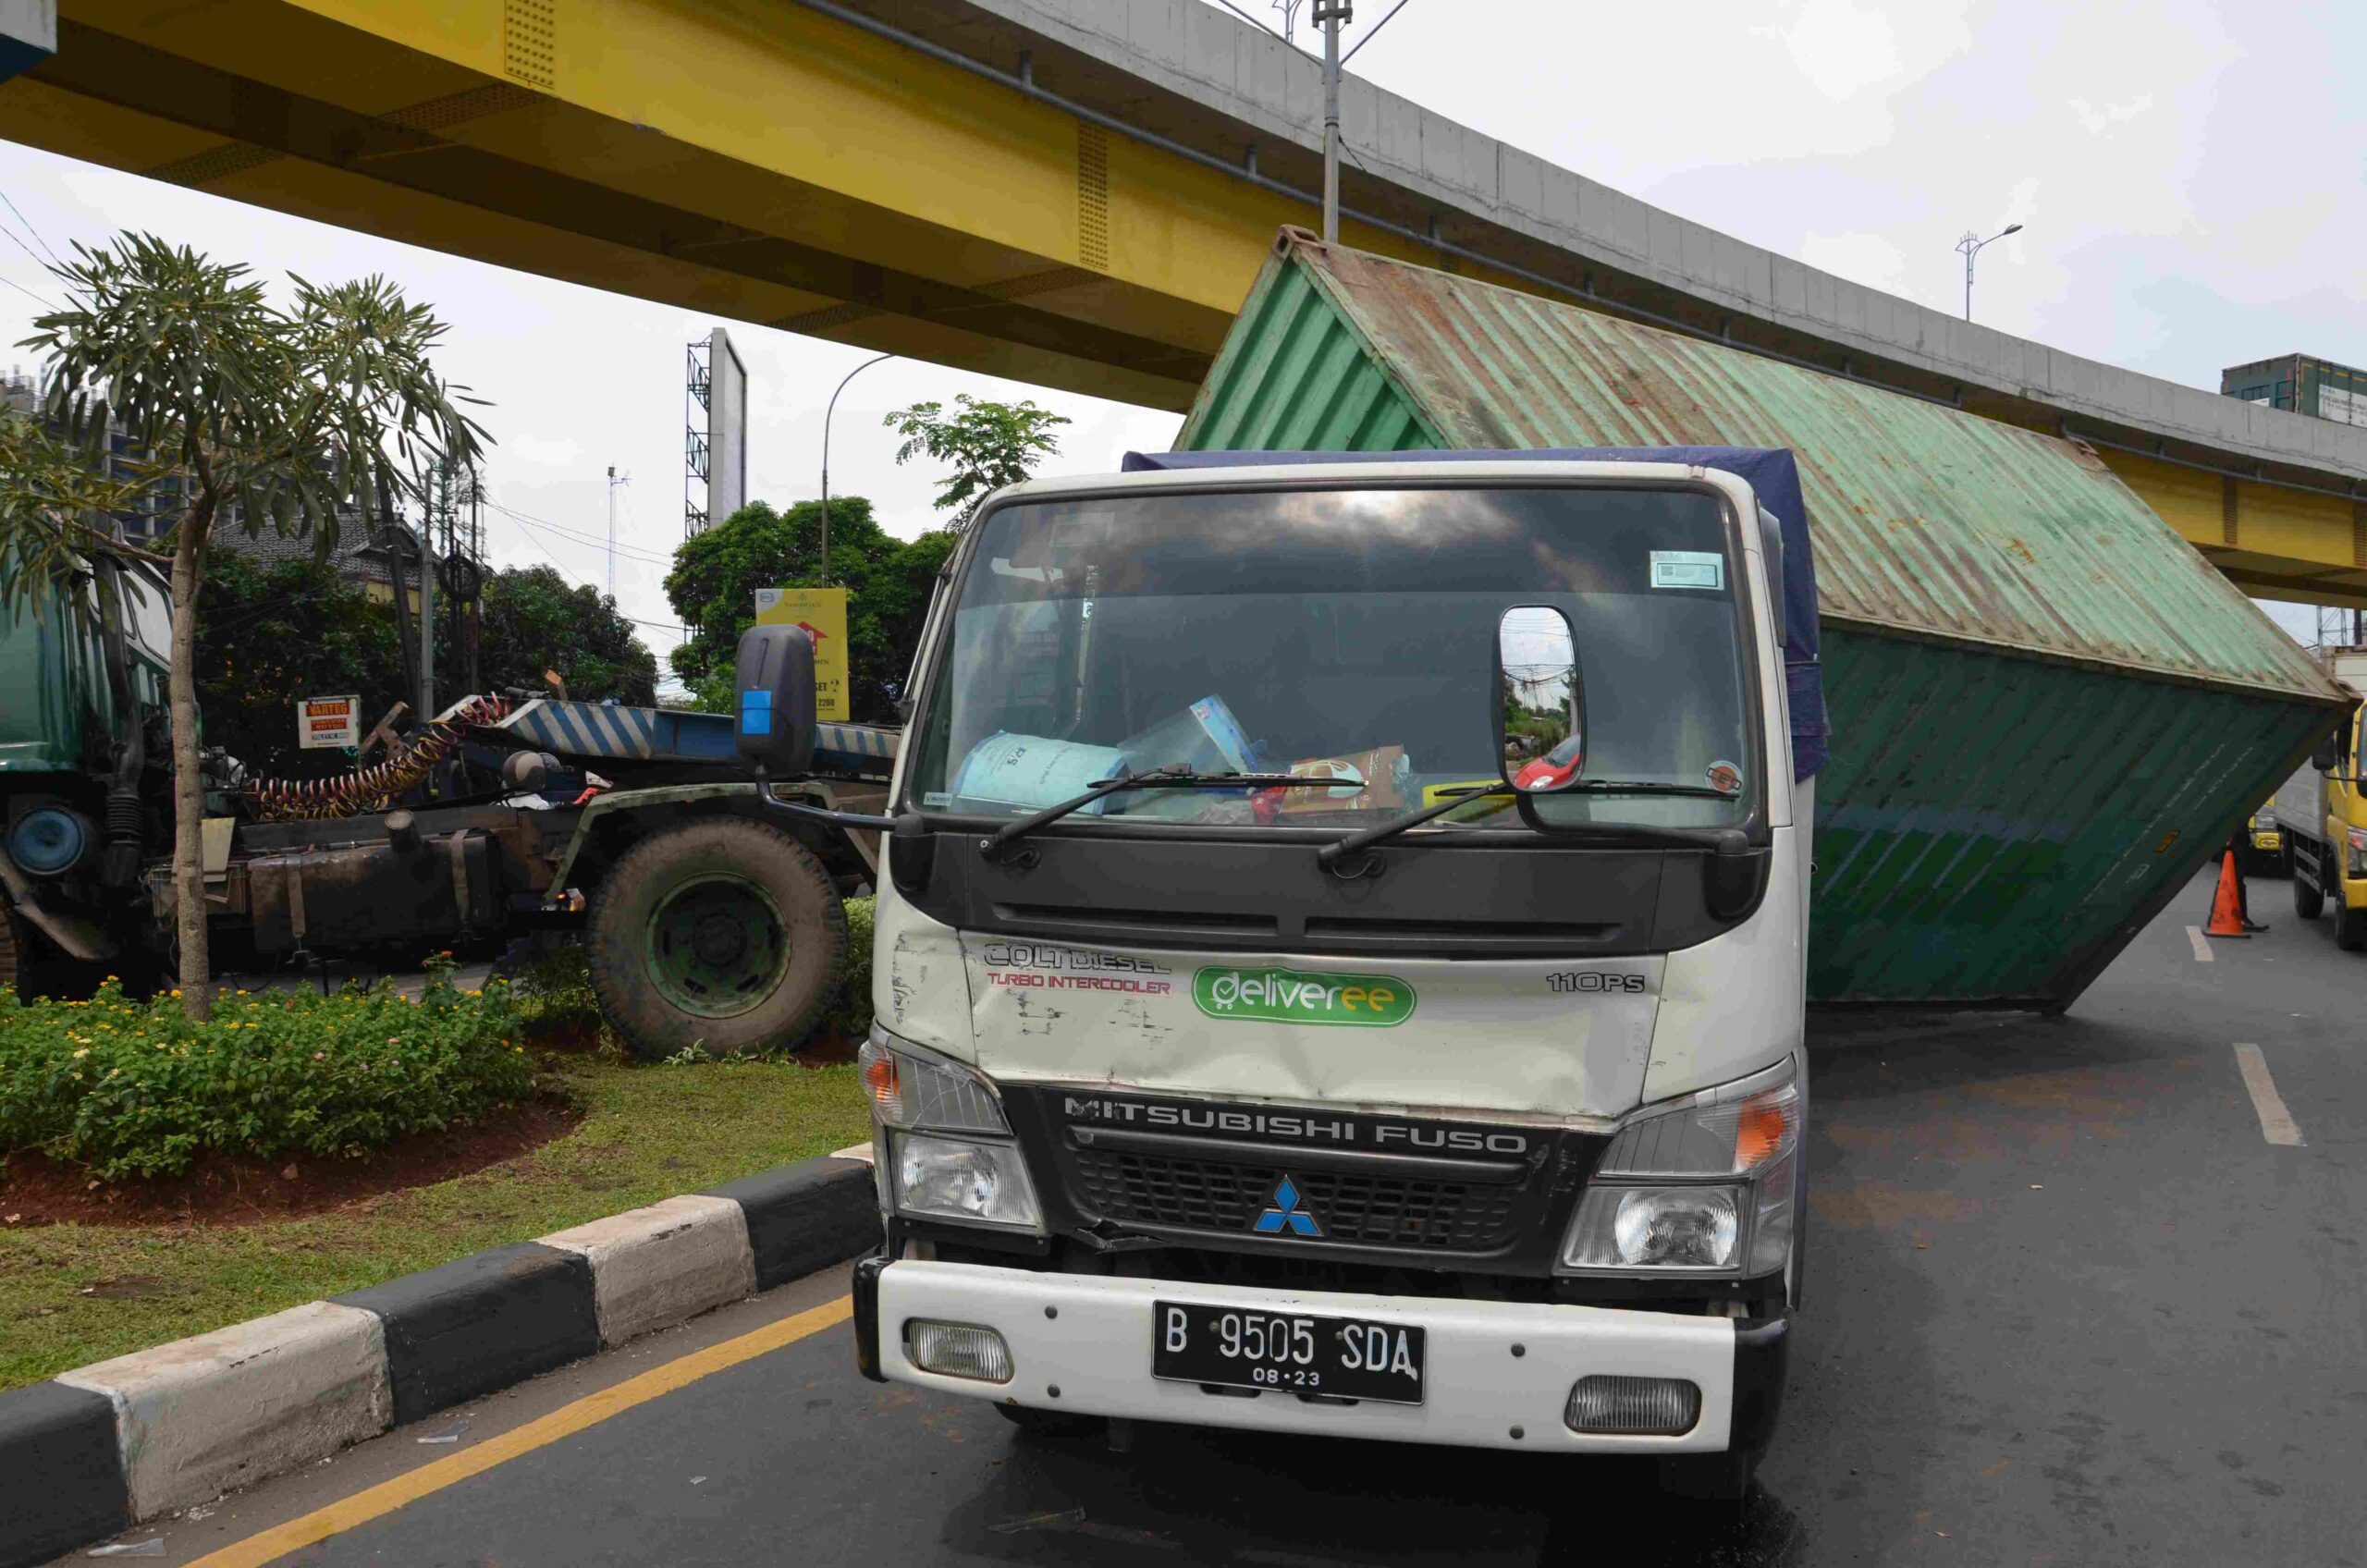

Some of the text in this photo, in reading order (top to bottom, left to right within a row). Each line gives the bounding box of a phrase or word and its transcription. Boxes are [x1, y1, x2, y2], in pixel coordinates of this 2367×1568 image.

[987, 973, 1171, 996] TURBO INTERCOOLER
[1211, 972, 1395, 1011] deliveree
[1546, 972, 1645, 994] 110PS
[1064, 1096, 1527, 1153] MITSUBISHI FUSO
[1166, 1307, 1417, 1381] B 9505 SDA
